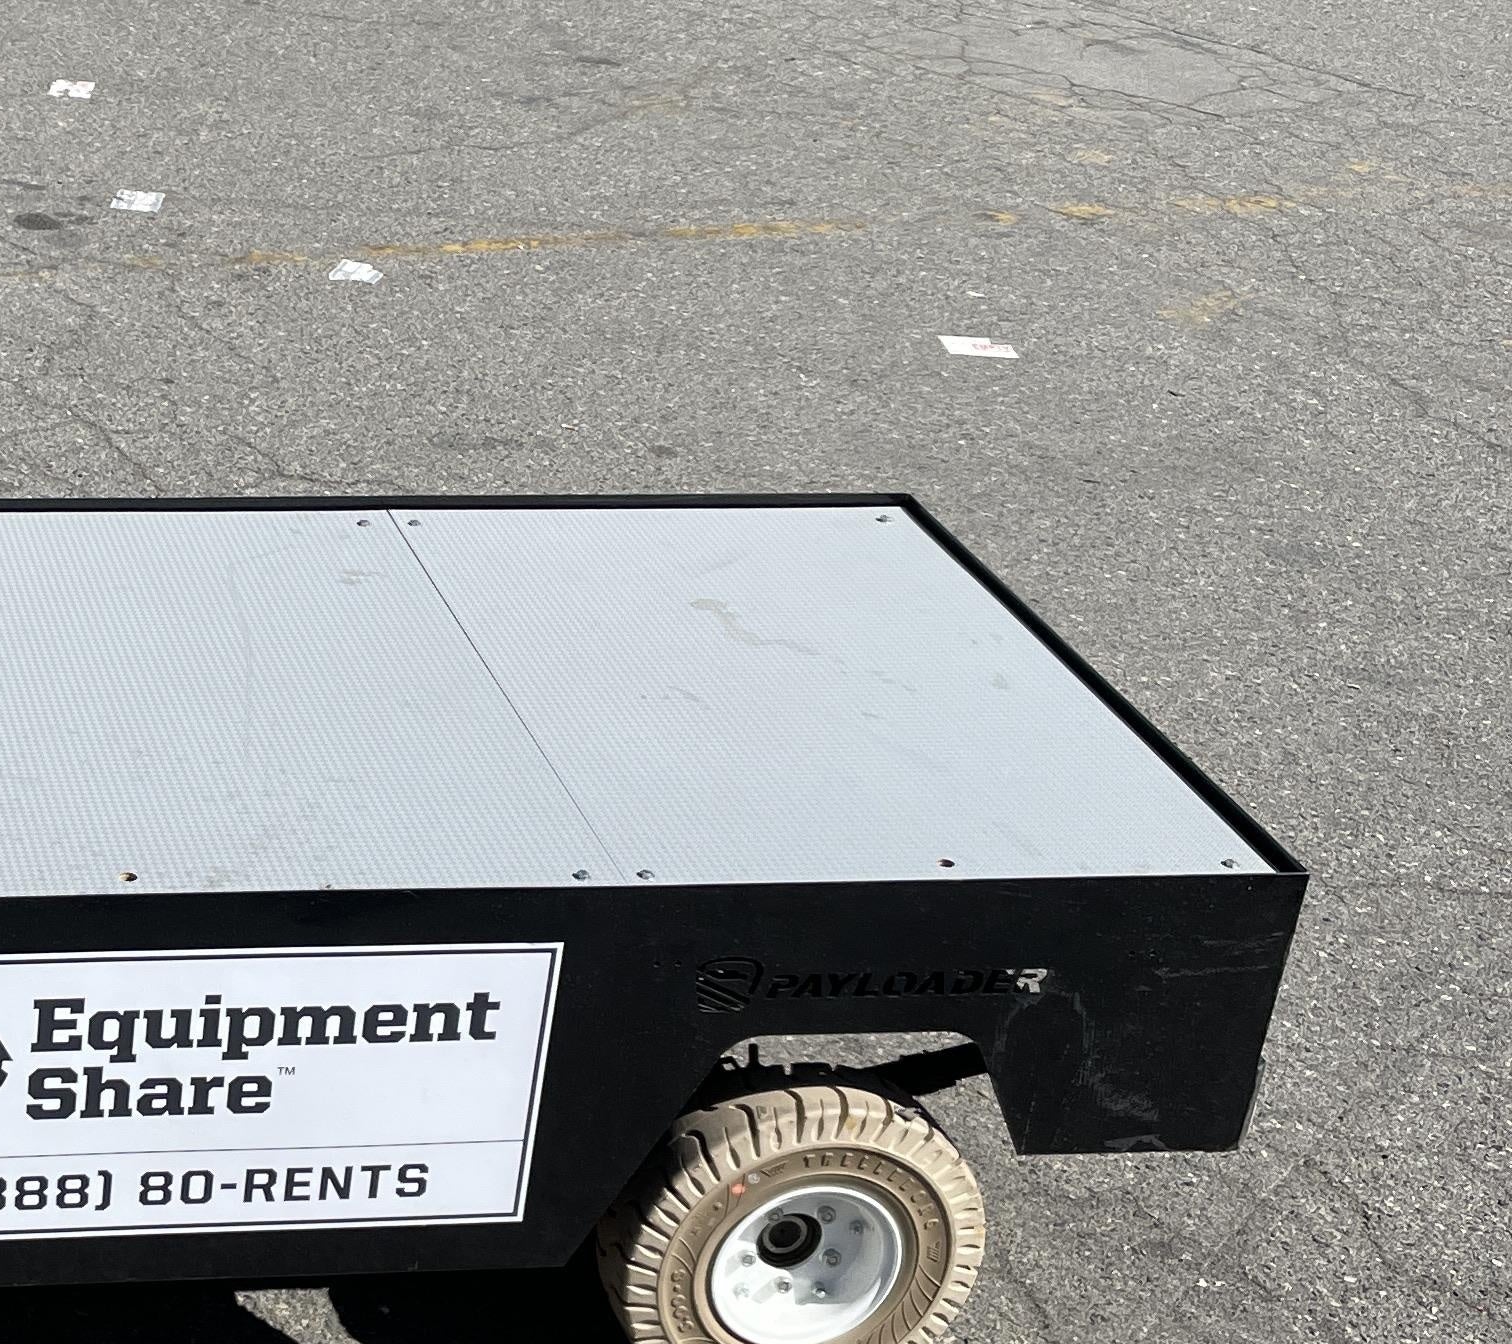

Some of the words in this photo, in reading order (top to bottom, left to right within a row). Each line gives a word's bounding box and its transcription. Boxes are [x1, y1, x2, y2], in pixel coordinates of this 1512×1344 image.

[765, 967, 1049, 999] PAYLOADER
[30, 992, 501, 1064] Equipment
[25, 1066, 274, 1121] Share
[138, 1163, 430, 1206] 80-RENTS
